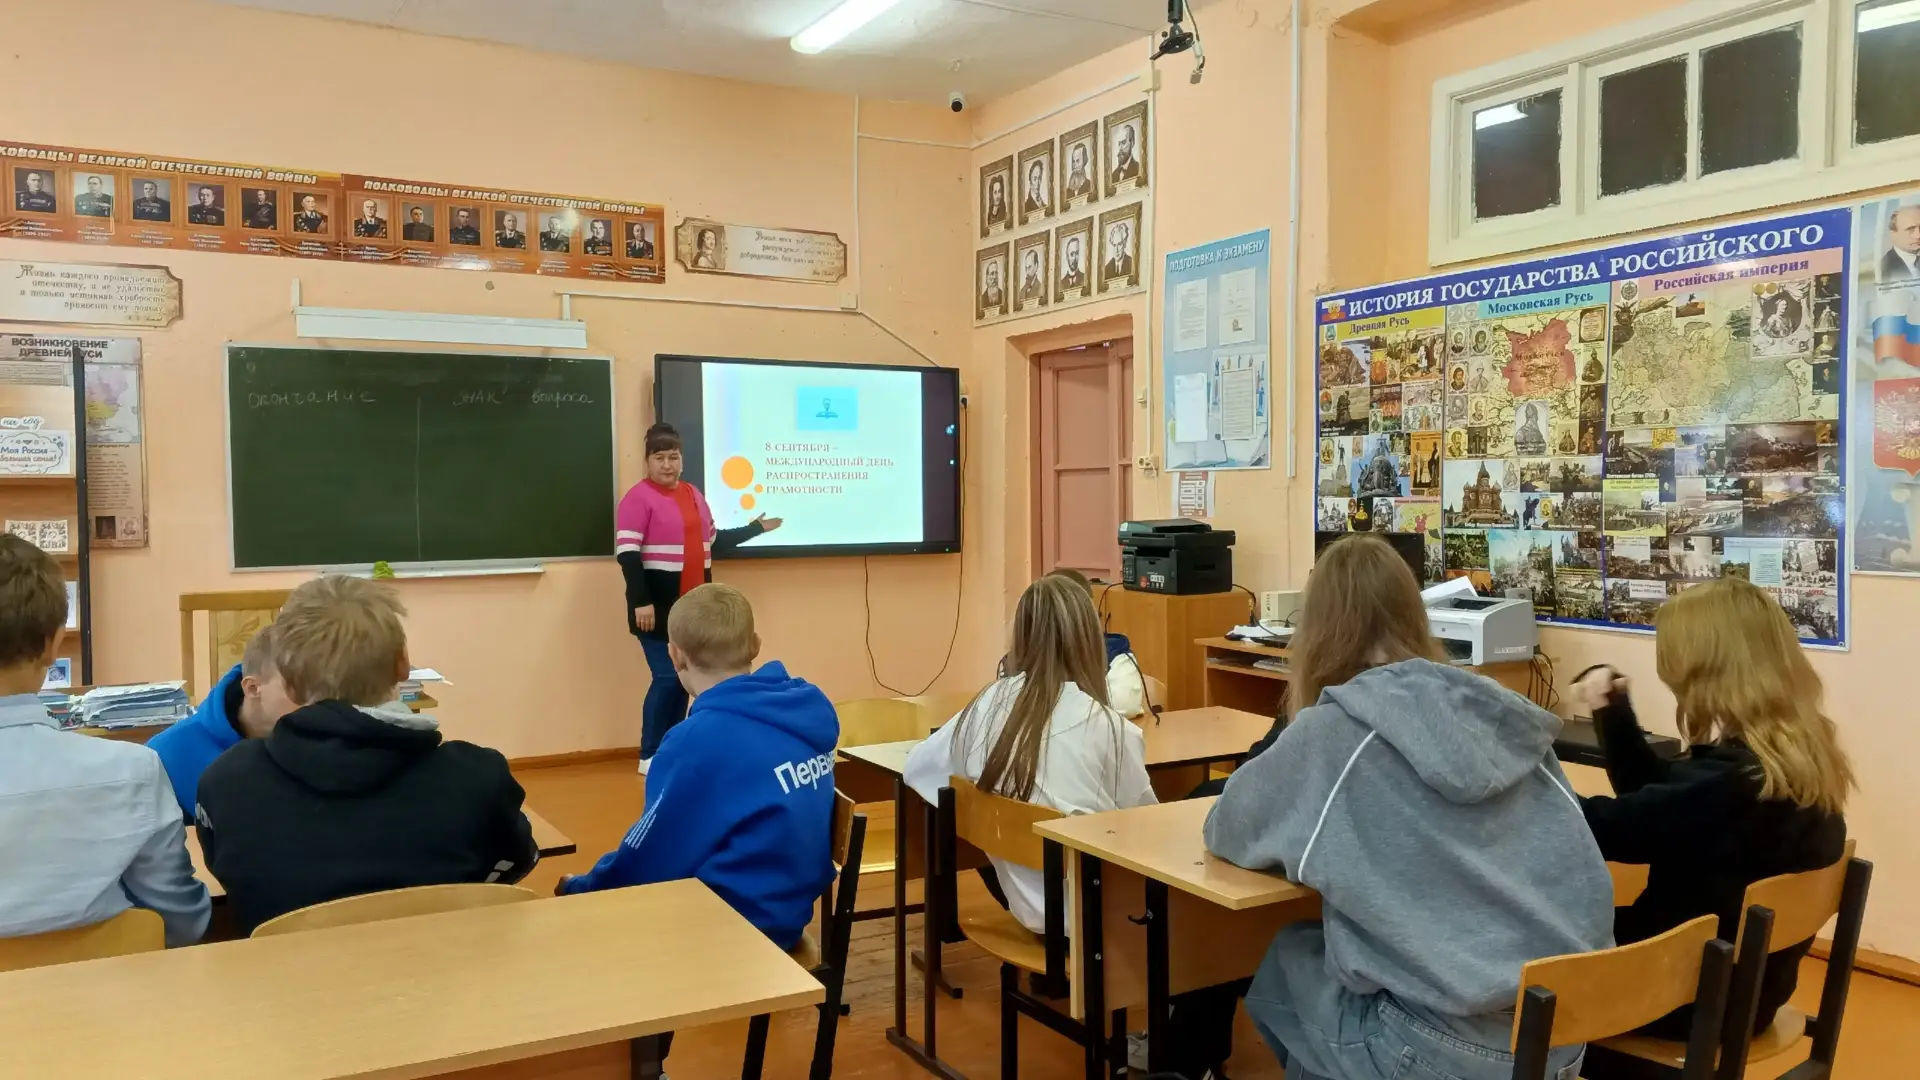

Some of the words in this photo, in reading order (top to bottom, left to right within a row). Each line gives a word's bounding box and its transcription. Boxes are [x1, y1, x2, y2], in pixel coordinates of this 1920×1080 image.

[78, 154, 147, 169] ВЕЛИКОЙ
[150, 160, 263, 180] ОТЕЧЕСТВЕННОЙ
[266, 170, 317, 185] ВОЙНЫ
[364, 180, 449, 197] ПОЛКОВОДЦЫ
[452, 189, 507, 202] ВЕЛИКОЙ
[510, 194, 601, 211] ОТЕЧЕСТВЕННОЙ
[603, 202, 645, 215] ВОЙНЫ
[1169, 251, 1215, 272] ПОДГОТОВКА
[1216, 249, 1224, 262] К
[1223, 239, 1265, 260] ЭКЗАМЕНУ
[1349, 288, 1434, 316] ИСТОРИЯ
[1441, 261, 1601, 299] ГОСУДАРСТВА
[1609, 224, 1824, 276] РОССИЙСКОГО
[1654, 271, 1734, 291] Российская
[1739, 260, 1809, 278] империя
[1487, 296, 1561, 314] Московская
[1565, 292, 1594, 305] Русь
[1349, 322, 1386, 335] Древняя
[1389, 317, 1410, 328] Русь
[11, 337, 108, 349] ВОЗНИКНОВЕНИЕ
[19, 347, 72, 358] ДРЕВНЕЙ
[81, 349, 103, 358] УСИ
[0, 446, 19, 454] Моя
[21, 445, 48, 454] Россия
[765, 442, 772, 451] 8
[775, 443, 830, 452] СЕНТЯБРЯ
[766, 456, 864, 467] МЕЖДУНАРОДНЫЙ
[866, 458, 894, 467] ДЕНЬ
[766, 471, 868, 480] РАСПРОСТРАНЕНИЯ
[766, 485, 843, 494] ГРАМОТНОСТИ
